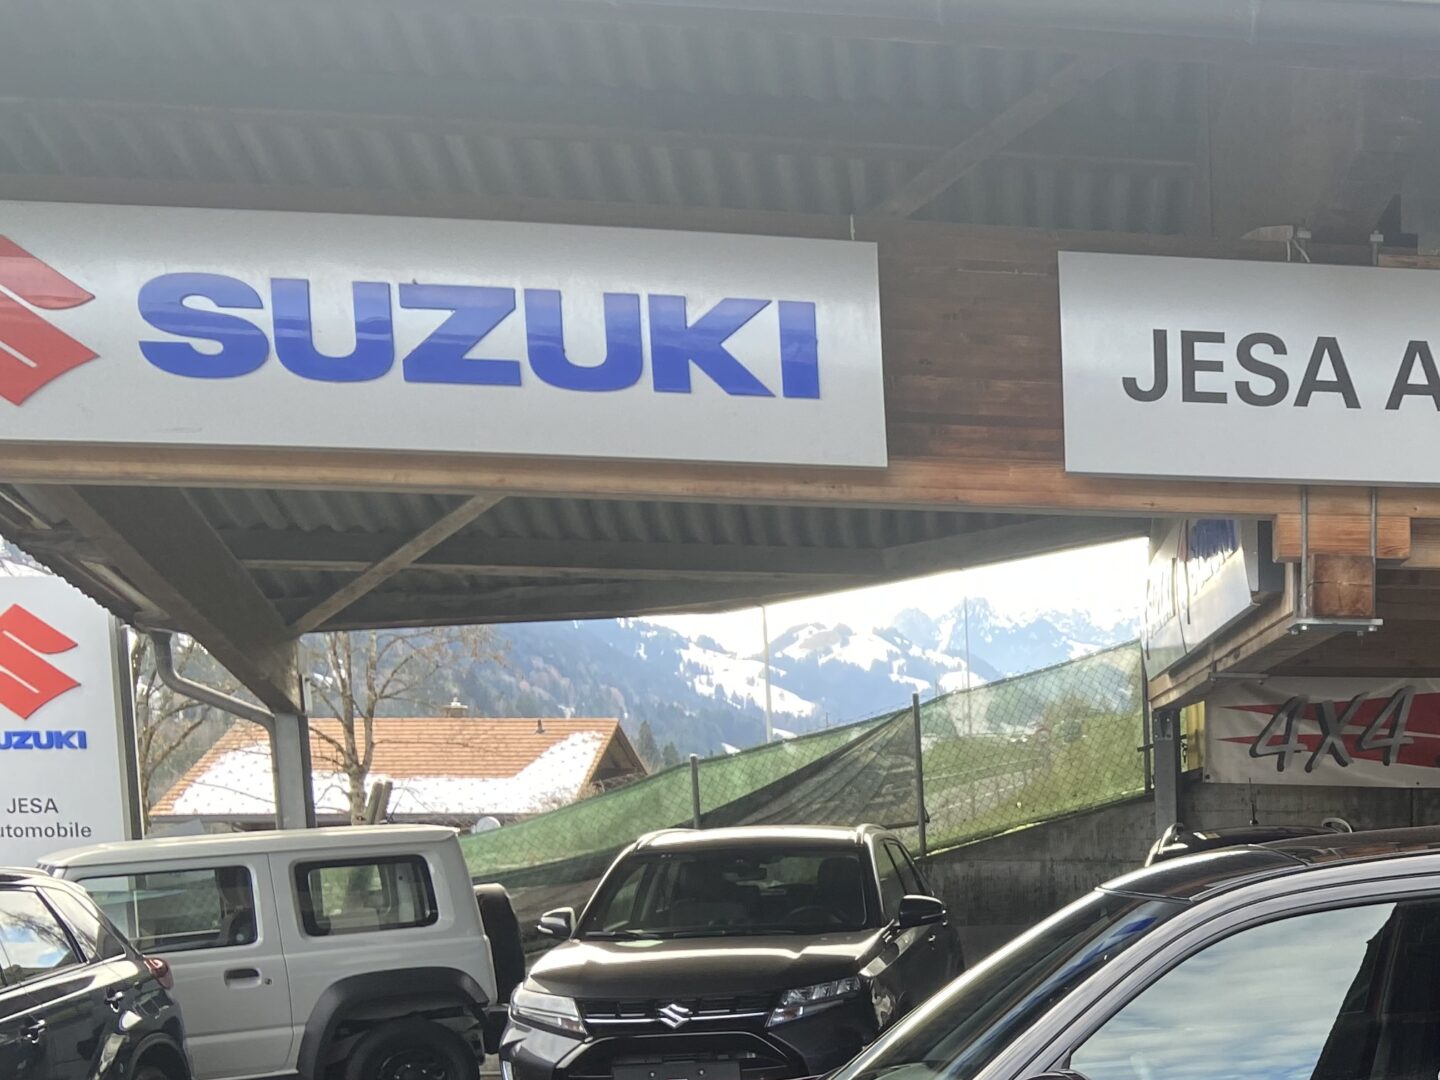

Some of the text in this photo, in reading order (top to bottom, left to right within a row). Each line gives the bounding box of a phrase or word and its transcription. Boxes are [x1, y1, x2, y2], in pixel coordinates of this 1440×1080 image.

[138, 272, 822, 400] SUZUKI
[1122, 328, 1362, 409] JESA
[0, 729, 88, 751] UZUKI
[6, 797, 60, 814] JESA
[0, 821, 92, 838] tomobile
